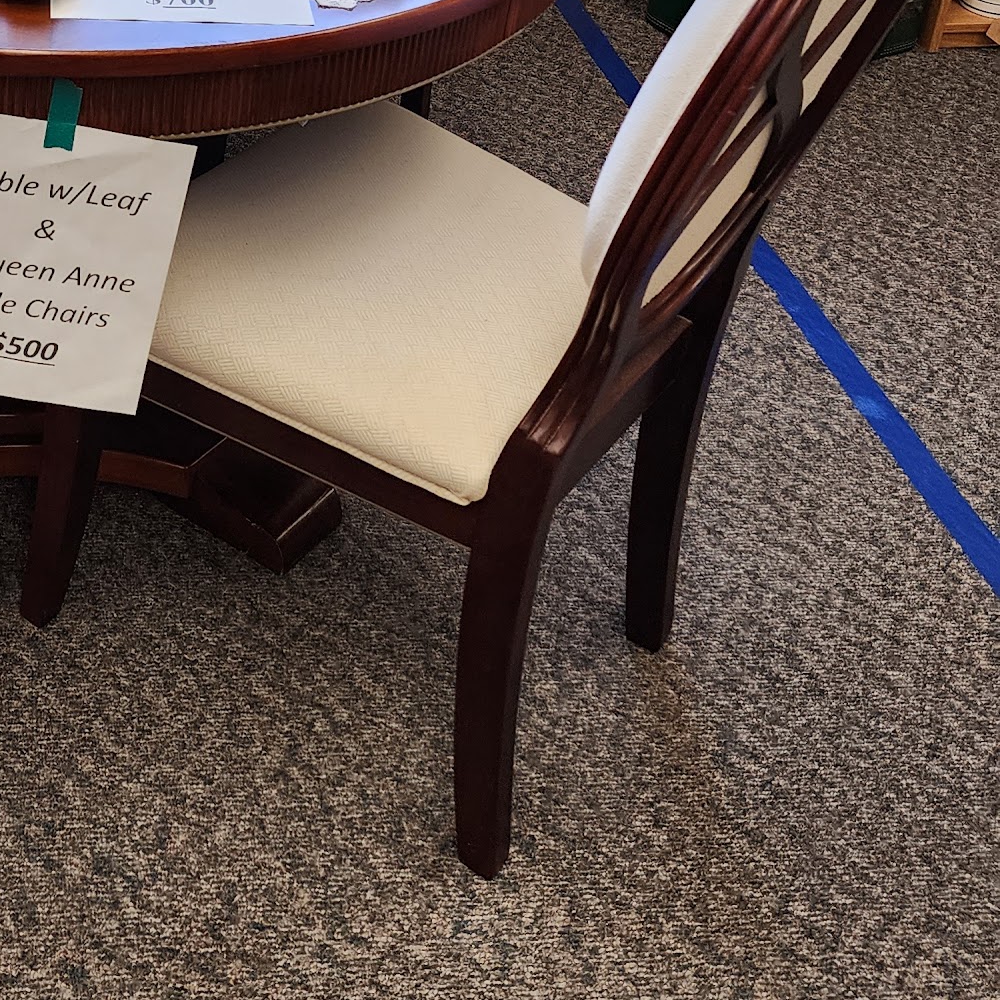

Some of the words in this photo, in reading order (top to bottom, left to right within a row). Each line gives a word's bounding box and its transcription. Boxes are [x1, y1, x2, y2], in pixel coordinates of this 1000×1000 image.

[49, 181, 152, 216] w/Leaf
[34, 219, 56, 241] &
[62, 266, 136, 293] Anne
[25, 299, 111, 328] Chairs
